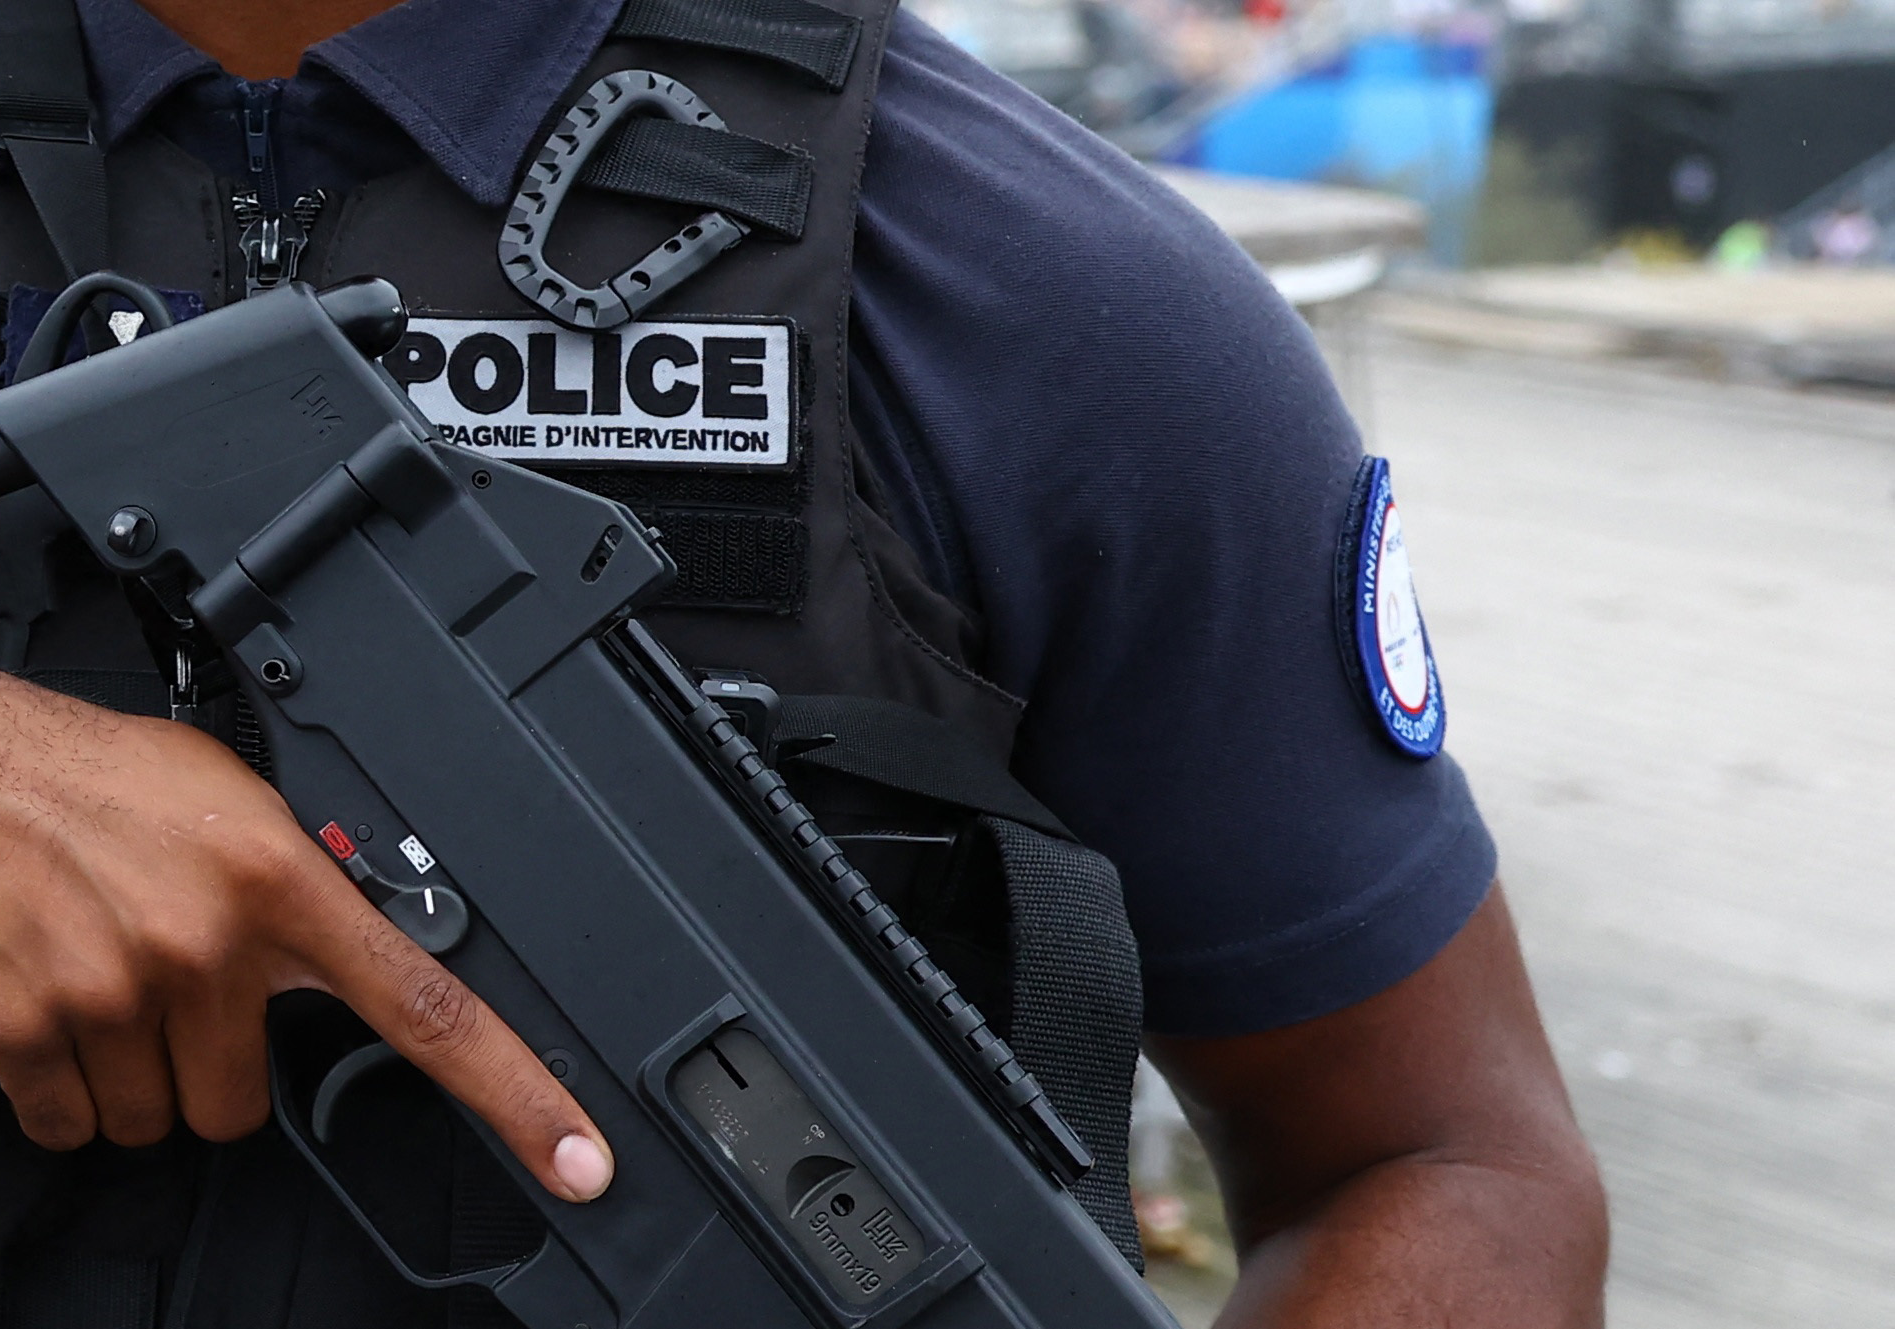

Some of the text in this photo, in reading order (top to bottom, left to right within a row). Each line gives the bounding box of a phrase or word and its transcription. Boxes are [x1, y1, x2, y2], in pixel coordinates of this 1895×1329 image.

[382, 331, 769, 420] POLICE
[433, 424, 770, 453] PAGNIE D'INTERVENTION
[809, 1210, 882, 1296] 9mmx19
